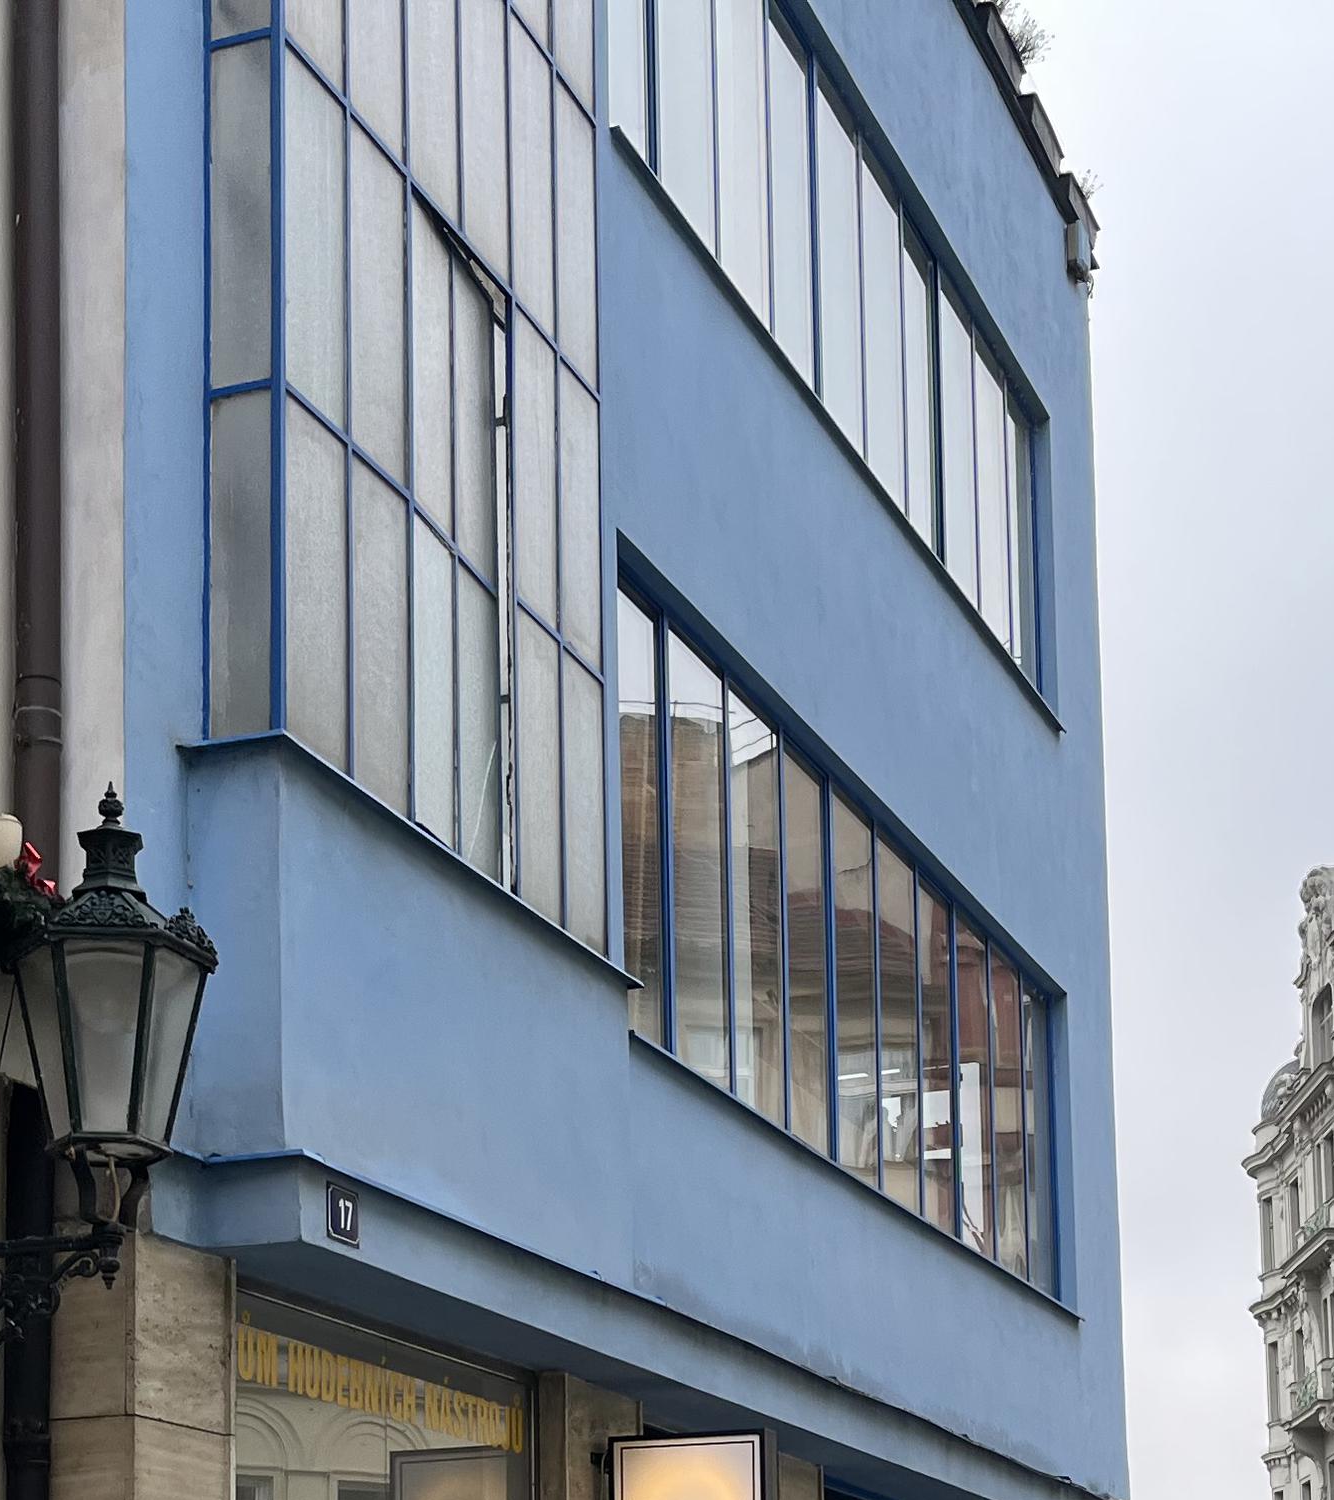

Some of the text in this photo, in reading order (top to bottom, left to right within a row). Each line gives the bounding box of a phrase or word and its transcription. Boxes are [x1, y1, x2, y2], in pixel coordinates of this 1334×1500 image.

[338, 1198, 353, 1231] 17
[237, 1311, 524, 1454] ŮM HUDEBNÍCH NÁSTROJŮ
